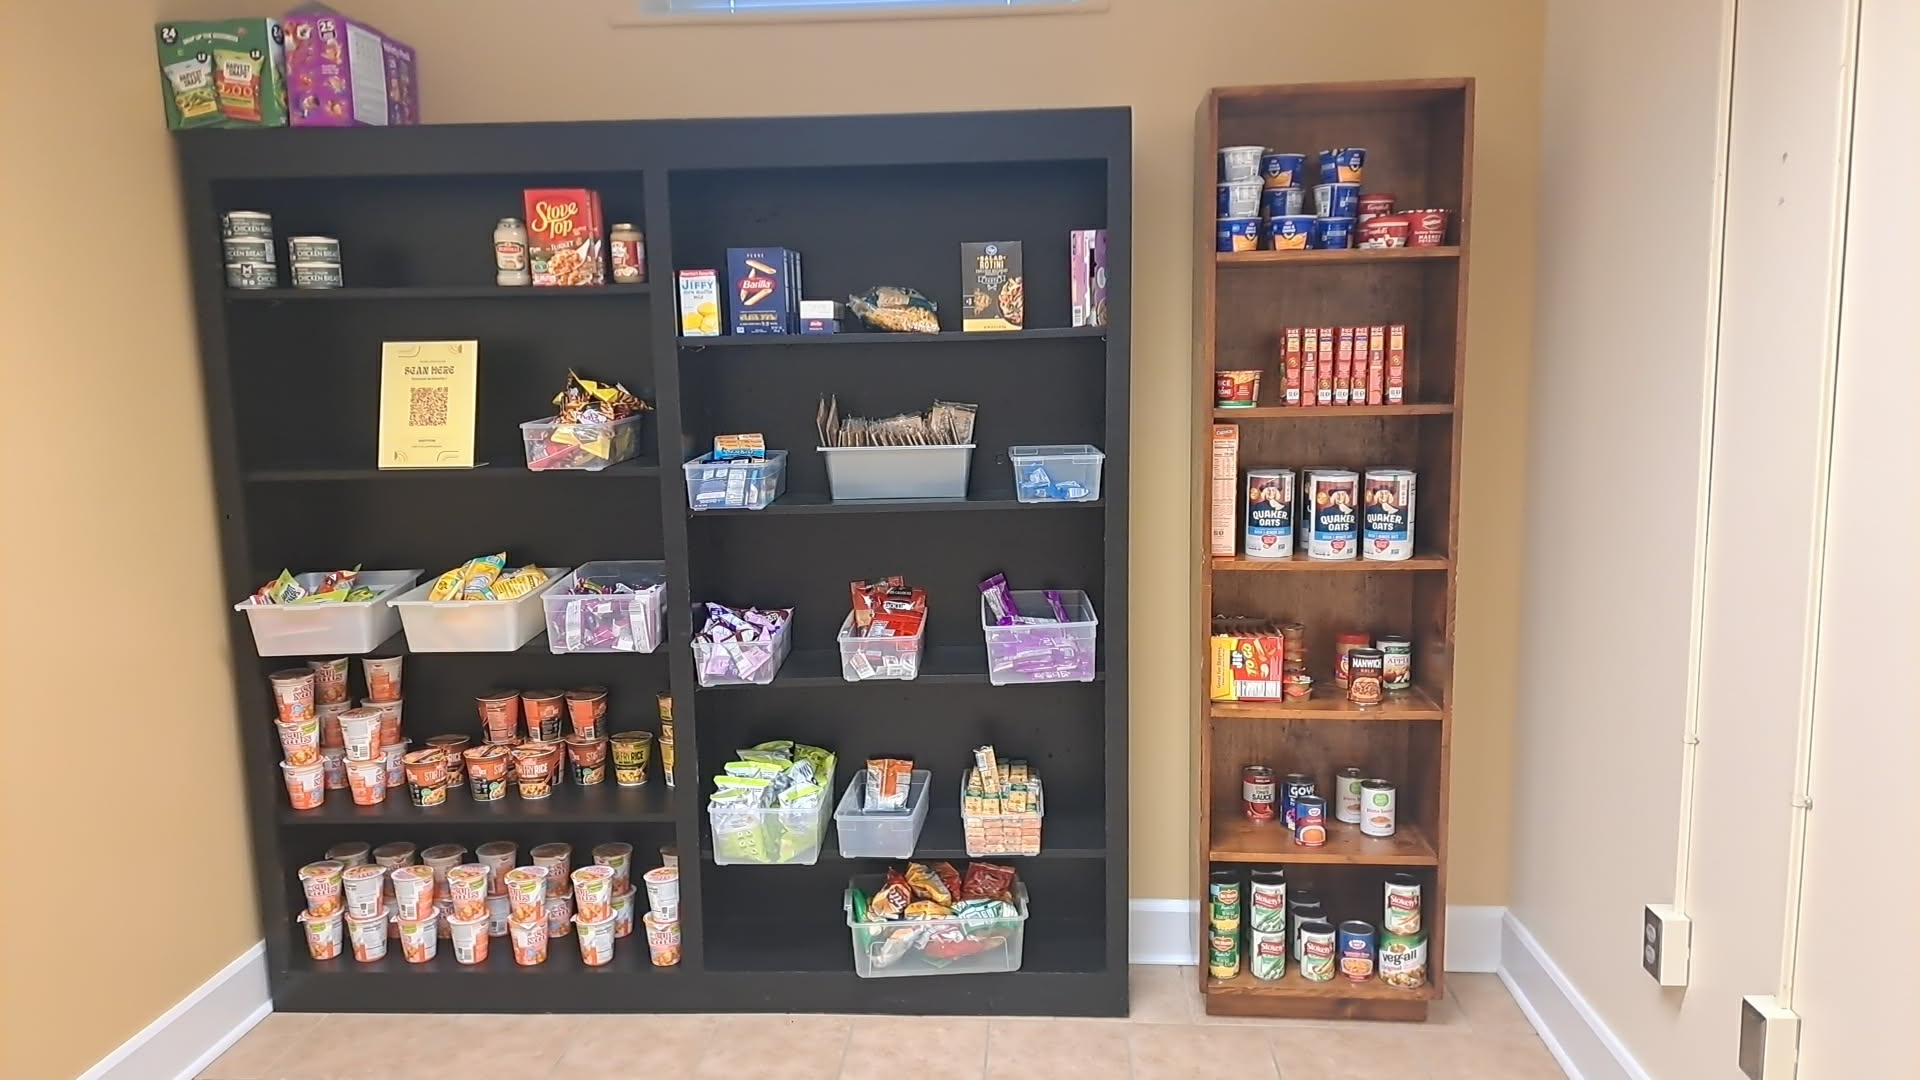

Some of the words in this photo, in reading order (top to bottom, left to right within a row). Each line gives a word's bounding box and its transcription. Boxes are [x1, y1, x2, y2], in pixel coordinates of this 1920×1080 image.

[162, 26, 177, 39] 24
[531, 201, 579, 233] Stove
[549, 220, 573, 239] Top
[979, 260, 1004, 269] ROTINI
[681, 280, 714, 290] JIFFY
[742, 280, 772, 289] Barilla
[404, 366, 429, 376] SCAN
[431, 365, 455, 375] HERE
[1252, 510, 1288, 520] QUAKER
[1320, 514, 1355, 525] QUAKER
[1366, 514, 1403, 524] QUAKER
[1258, 518, 1281, 527] OATS
[1328, 523, 1350, 531] OATS
[1372, 522, 1394, 531] OATS
[1240, 642, 1253, 658] GO
[1231, 651, 1243, 669] JIF
[1352, 657, 1382, 669] MANWICH
[631, 750, 644, 760] RICE
[1252, 793, 1272, 801] SAUCE
